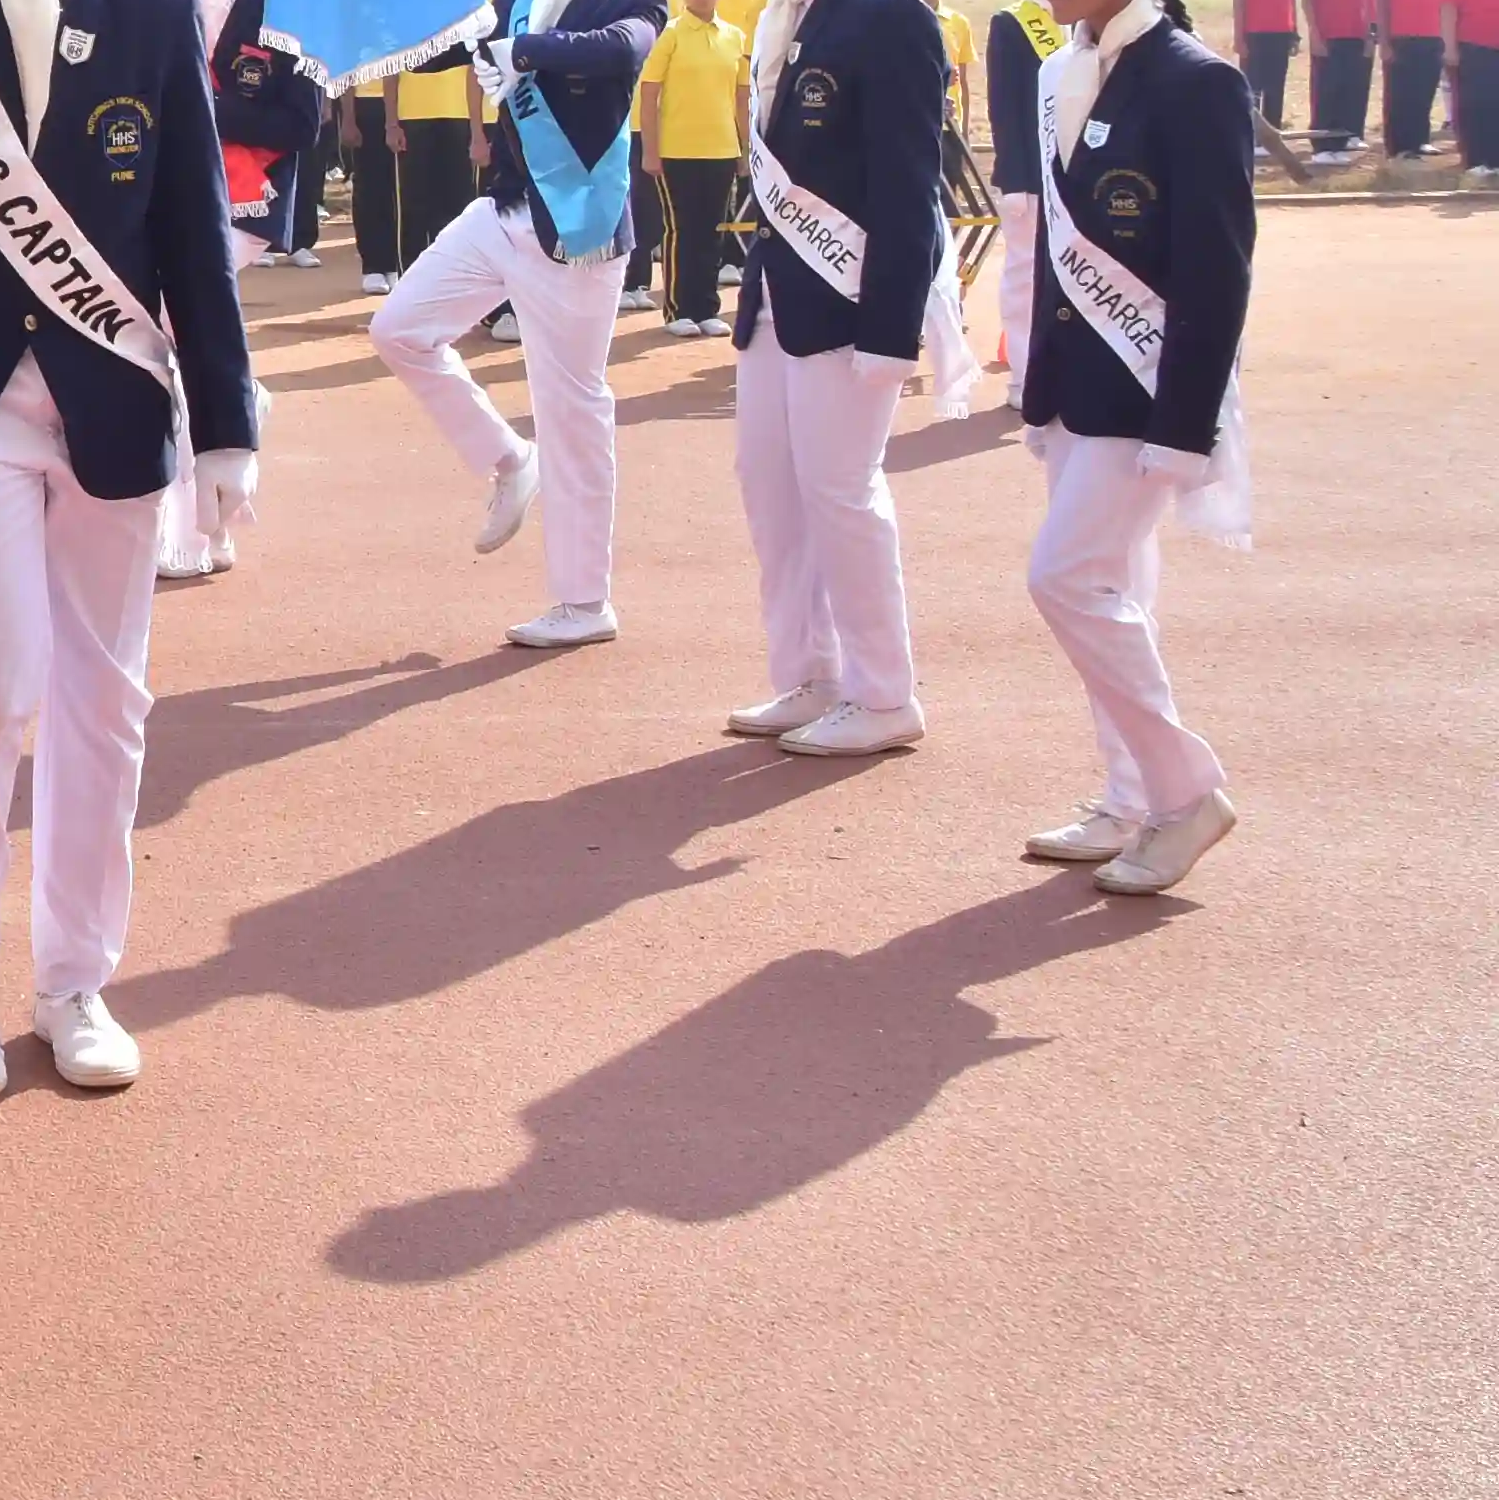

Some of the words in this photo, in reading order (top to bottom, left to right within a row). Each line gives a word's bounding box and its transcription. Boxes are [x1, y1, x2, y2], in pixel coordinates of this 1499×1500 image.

[113, 131, 136, 146] HHS
[111, 170, 136, 182] PUNE
[1112, 199, 1136, 209] HHS
[765, 183, 858, 276] INCHARGE
[1058, 246, 1164, 356] INCHARGE
